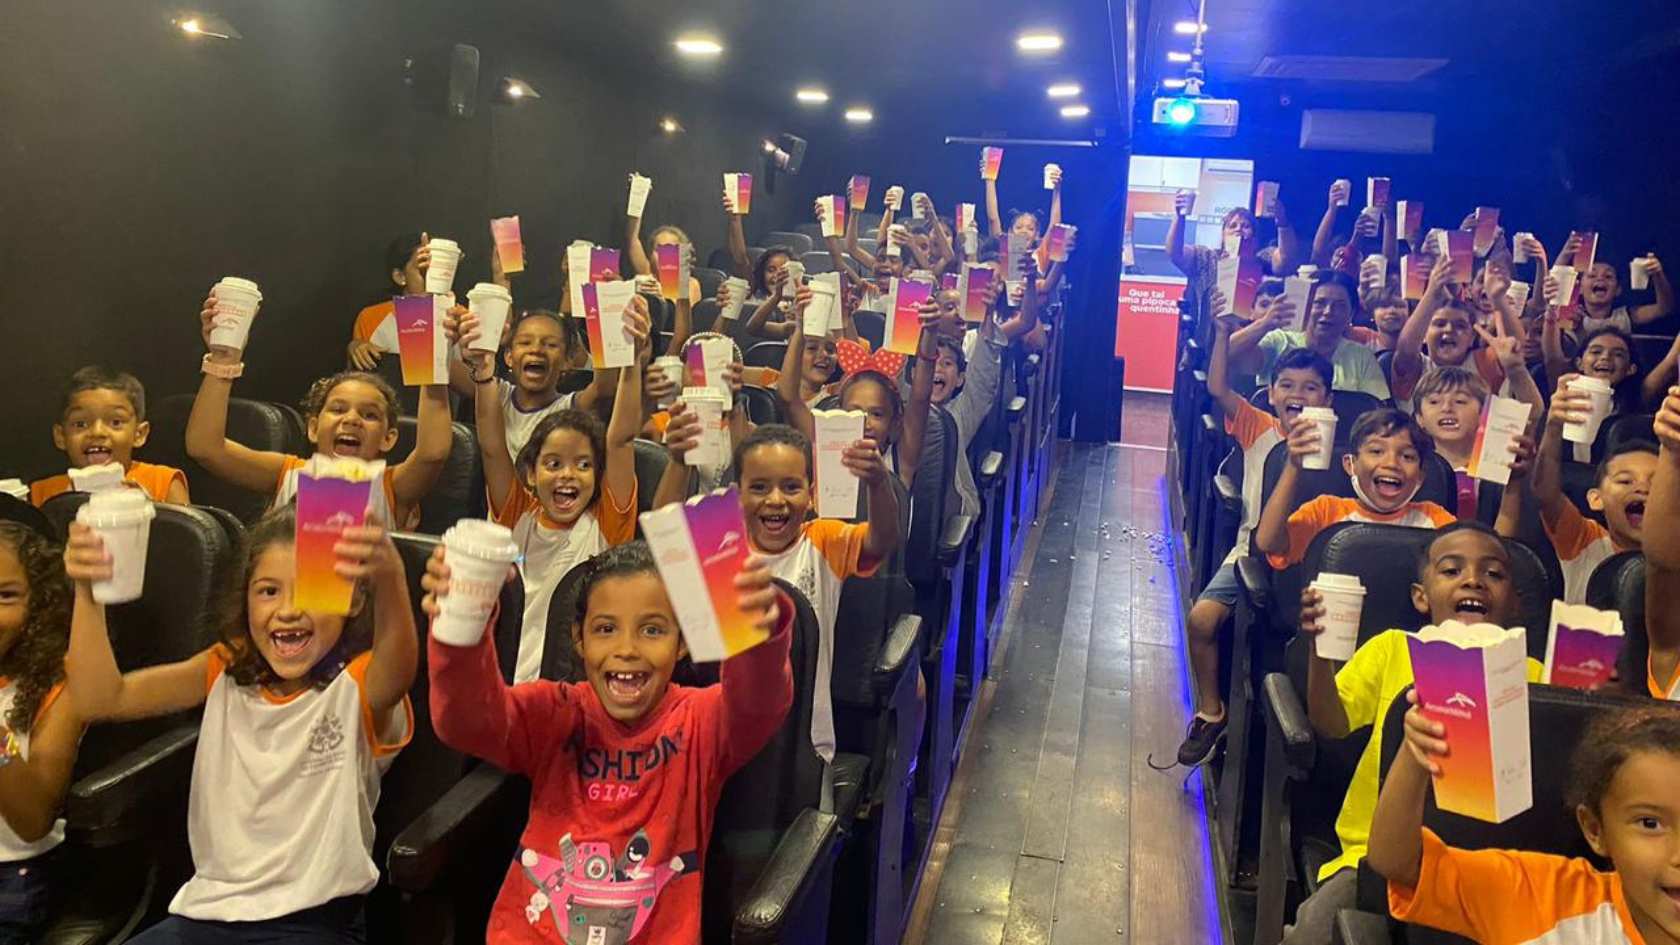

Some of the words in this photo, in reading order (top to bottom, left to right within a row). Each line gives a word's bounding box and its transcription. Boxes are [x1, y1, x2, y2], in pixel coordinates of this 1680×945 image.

[1129, 289, 1149, 298] Que
[1151, 290, 1165, 298] tal
[1119, 296, 1140, 304] uma
[1142, 297, 1176, 306] pipoca
[562, 730, 683, 781] ASHION
[588, 783, 639, 801] GIRL
